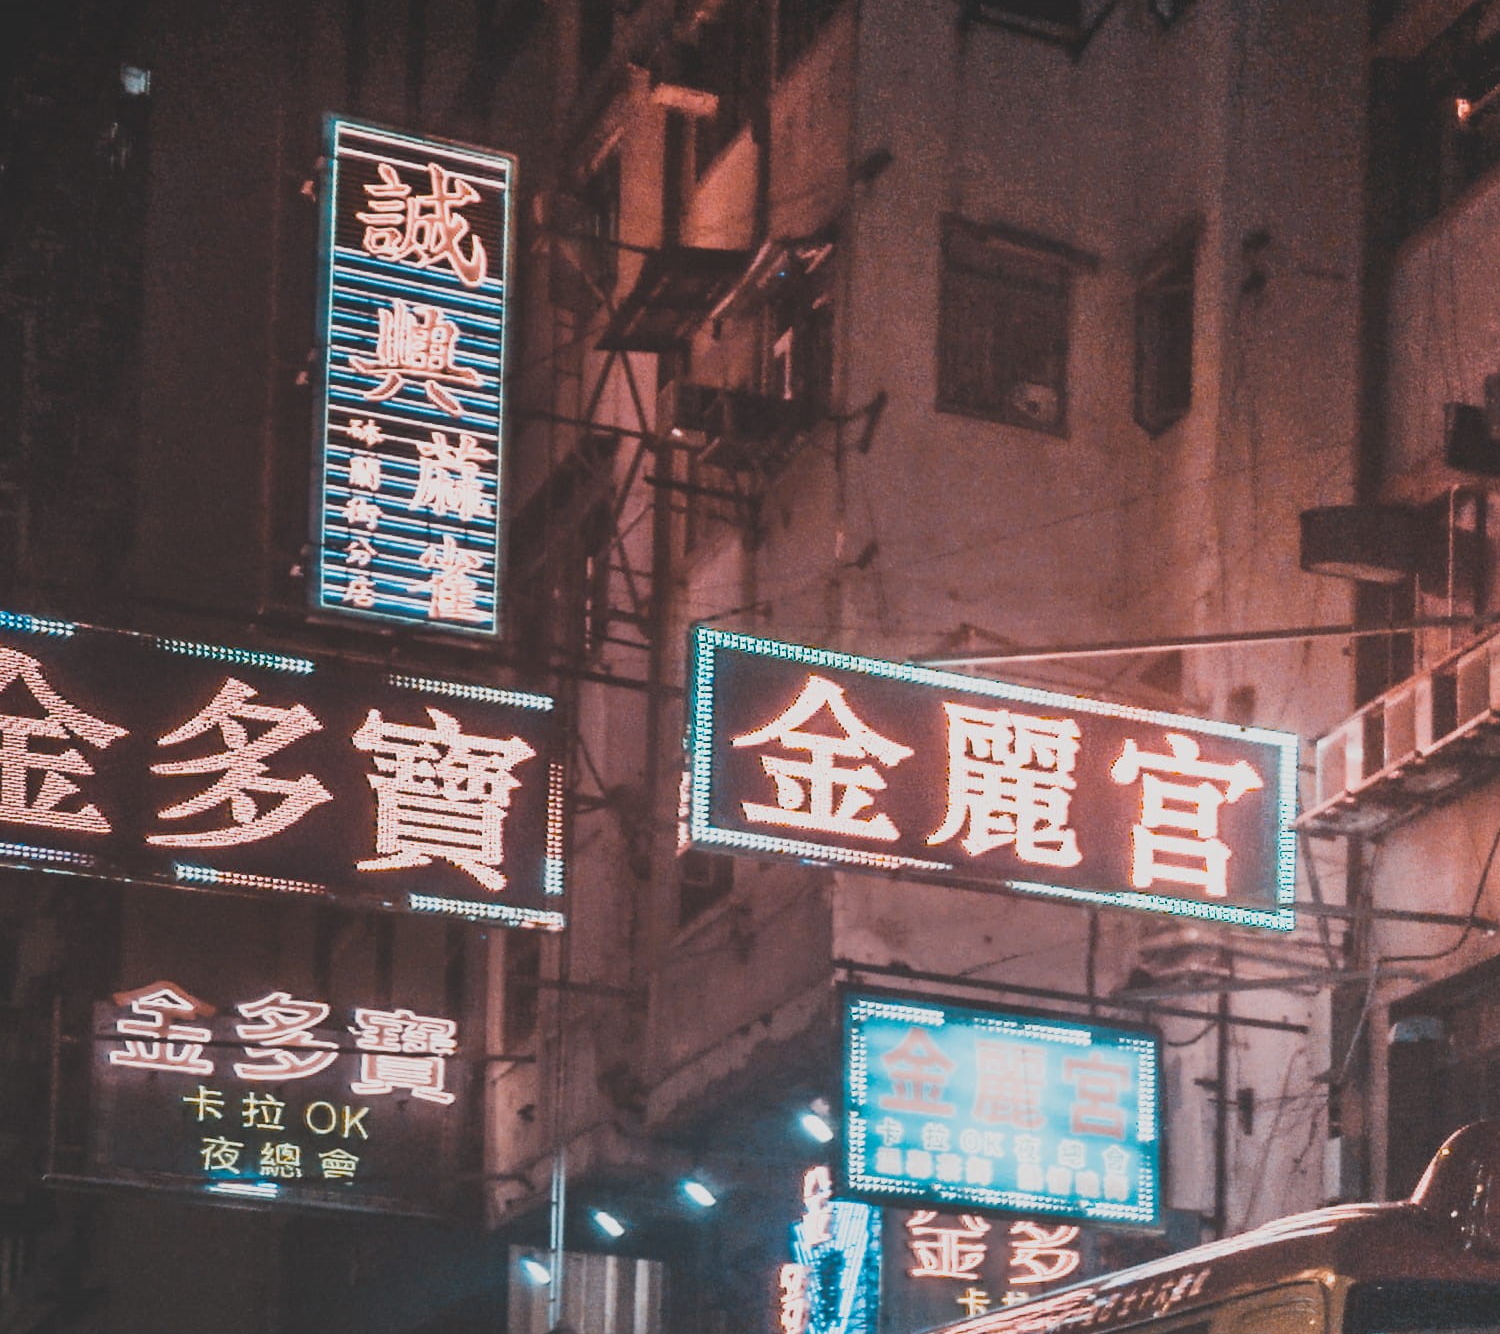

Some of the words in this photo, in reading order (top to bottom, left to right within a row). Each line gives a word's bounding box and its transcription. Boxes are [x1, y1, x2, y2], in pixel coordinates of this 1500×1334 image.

[109, 980, 457, 1105] 金多寶
[183, 1085, 370, 1140] 卡拉OK
[200, 1136, 361, 1181] 夜總會
